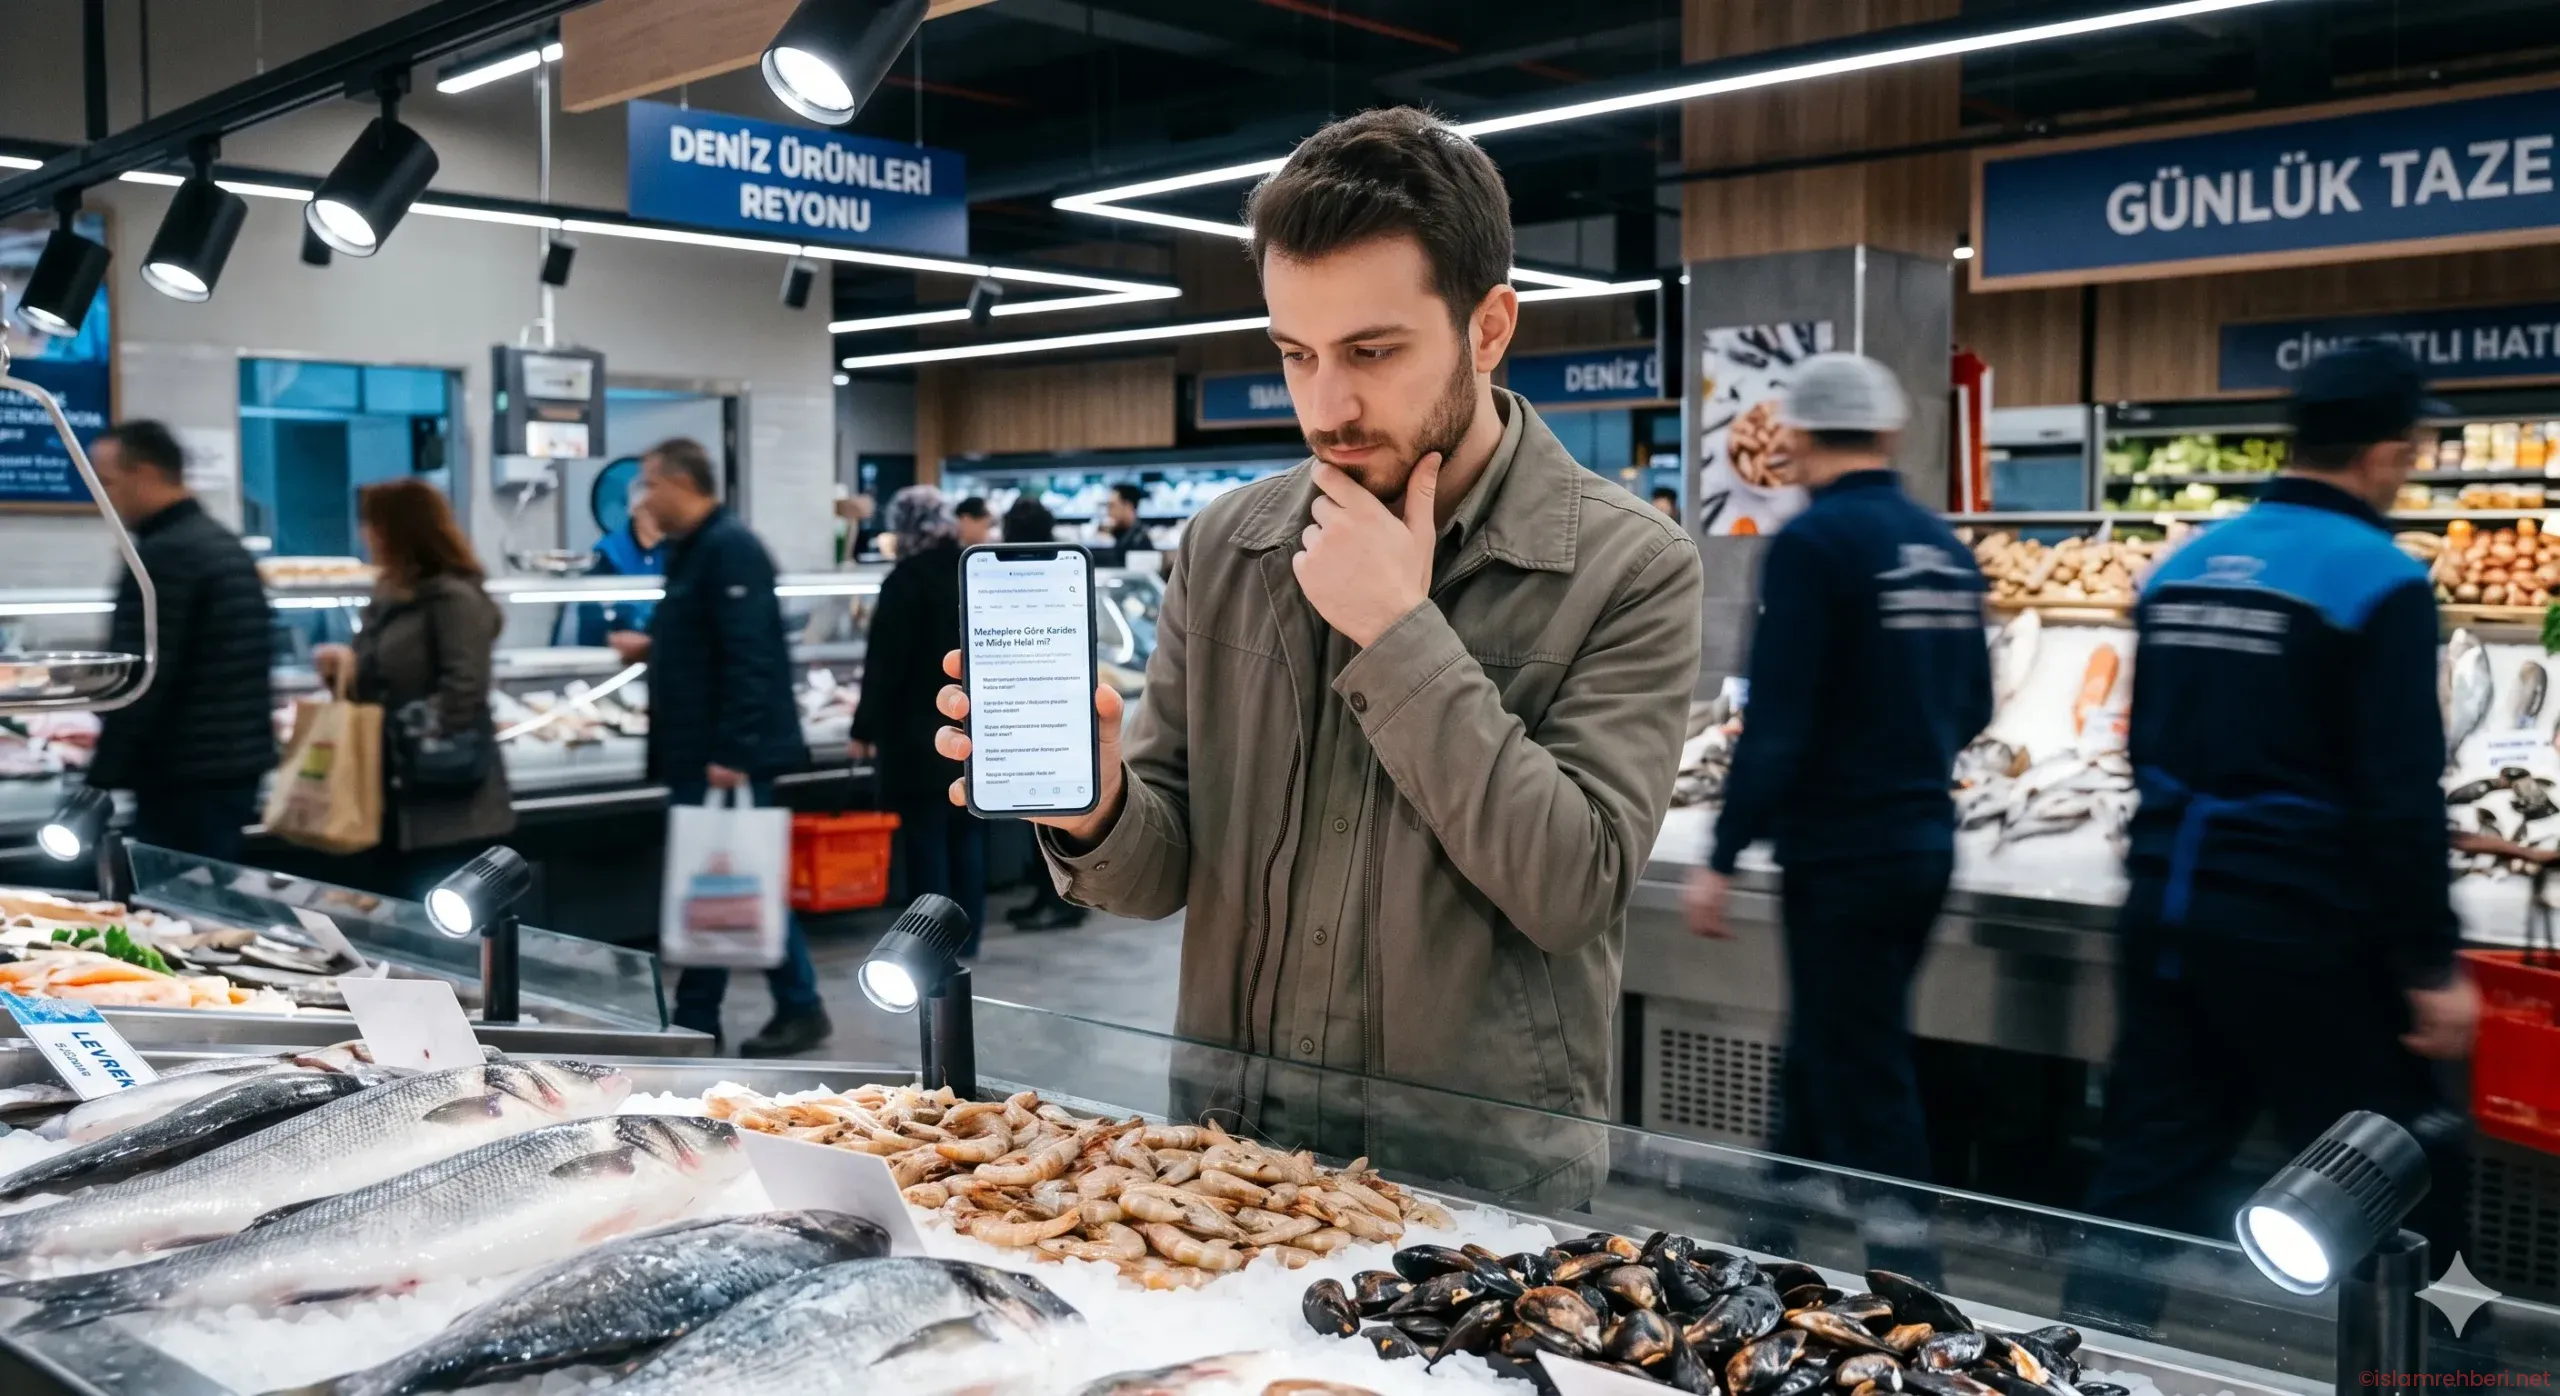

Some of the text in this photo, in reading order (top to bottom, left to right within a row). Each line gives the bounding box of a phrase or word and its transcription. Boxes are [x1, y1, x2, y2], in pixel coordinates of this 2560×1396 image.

[670, 125, 932, 196] DENİZ ÜRÜNLERİ
[740, 183, 871, 232] REYONU
[2106, 135, 2554, 236] GÜNLÜK TAZE
[1565, 357, 1639, 392] DENİZ
[974, 627, 1021, 637] Mezheplere
[1047, 626, 1077, 635] Karides
[986, 638, 1011, 648] Midye
[1014, 638, 1034, 646] Helal
[72, 1031, 137, 1088] LEVREK
